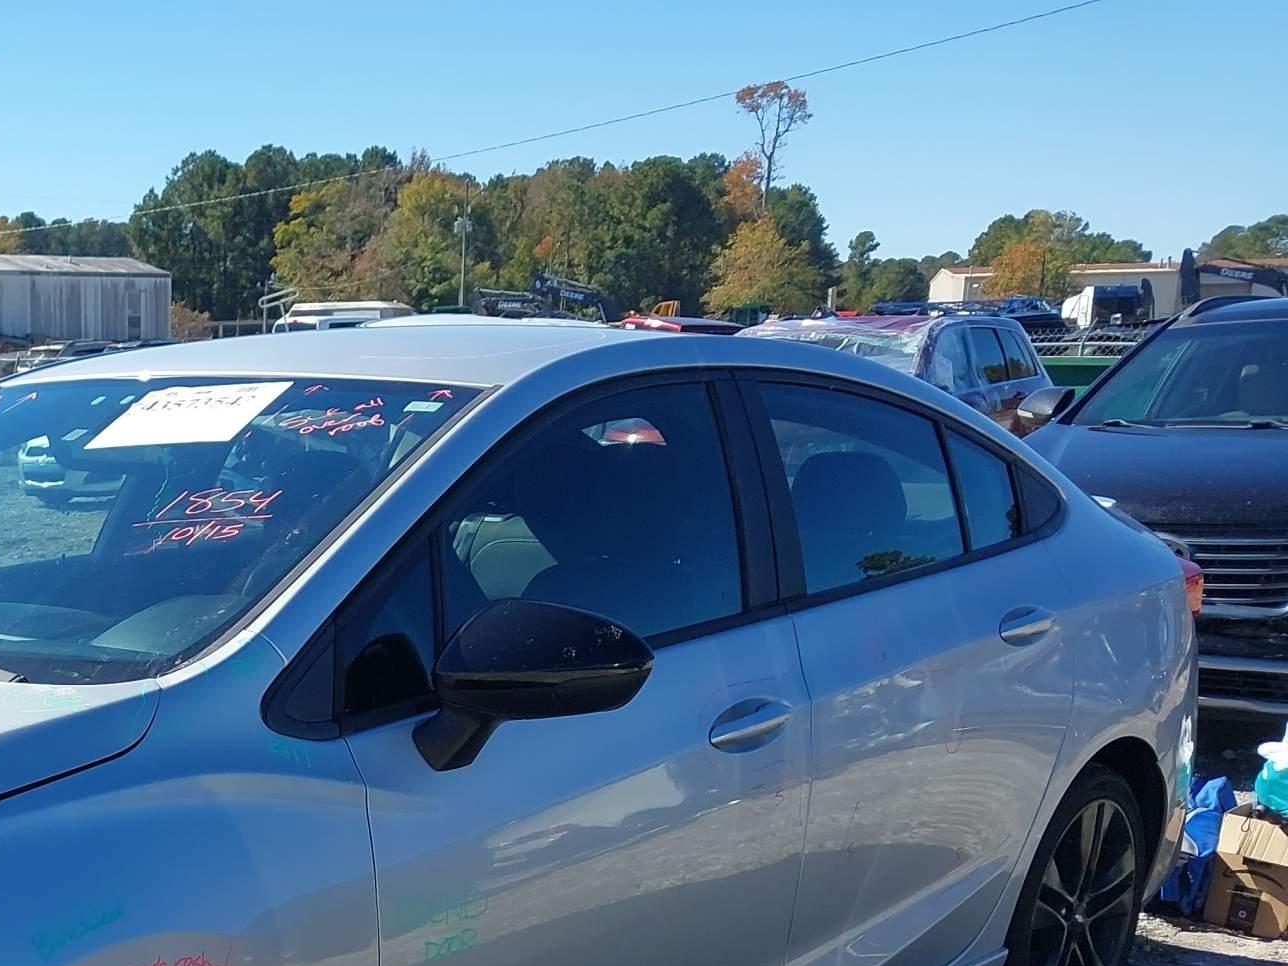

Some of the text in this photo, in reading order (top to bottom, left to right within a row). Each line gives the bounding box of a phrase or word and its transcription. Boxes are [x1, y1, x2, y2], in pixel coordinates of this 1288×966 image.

[1220, 268, 1254, 280] DEERE
[559, 289, 585, 300] DEERE
[156, 487, 284, 519] 1854
